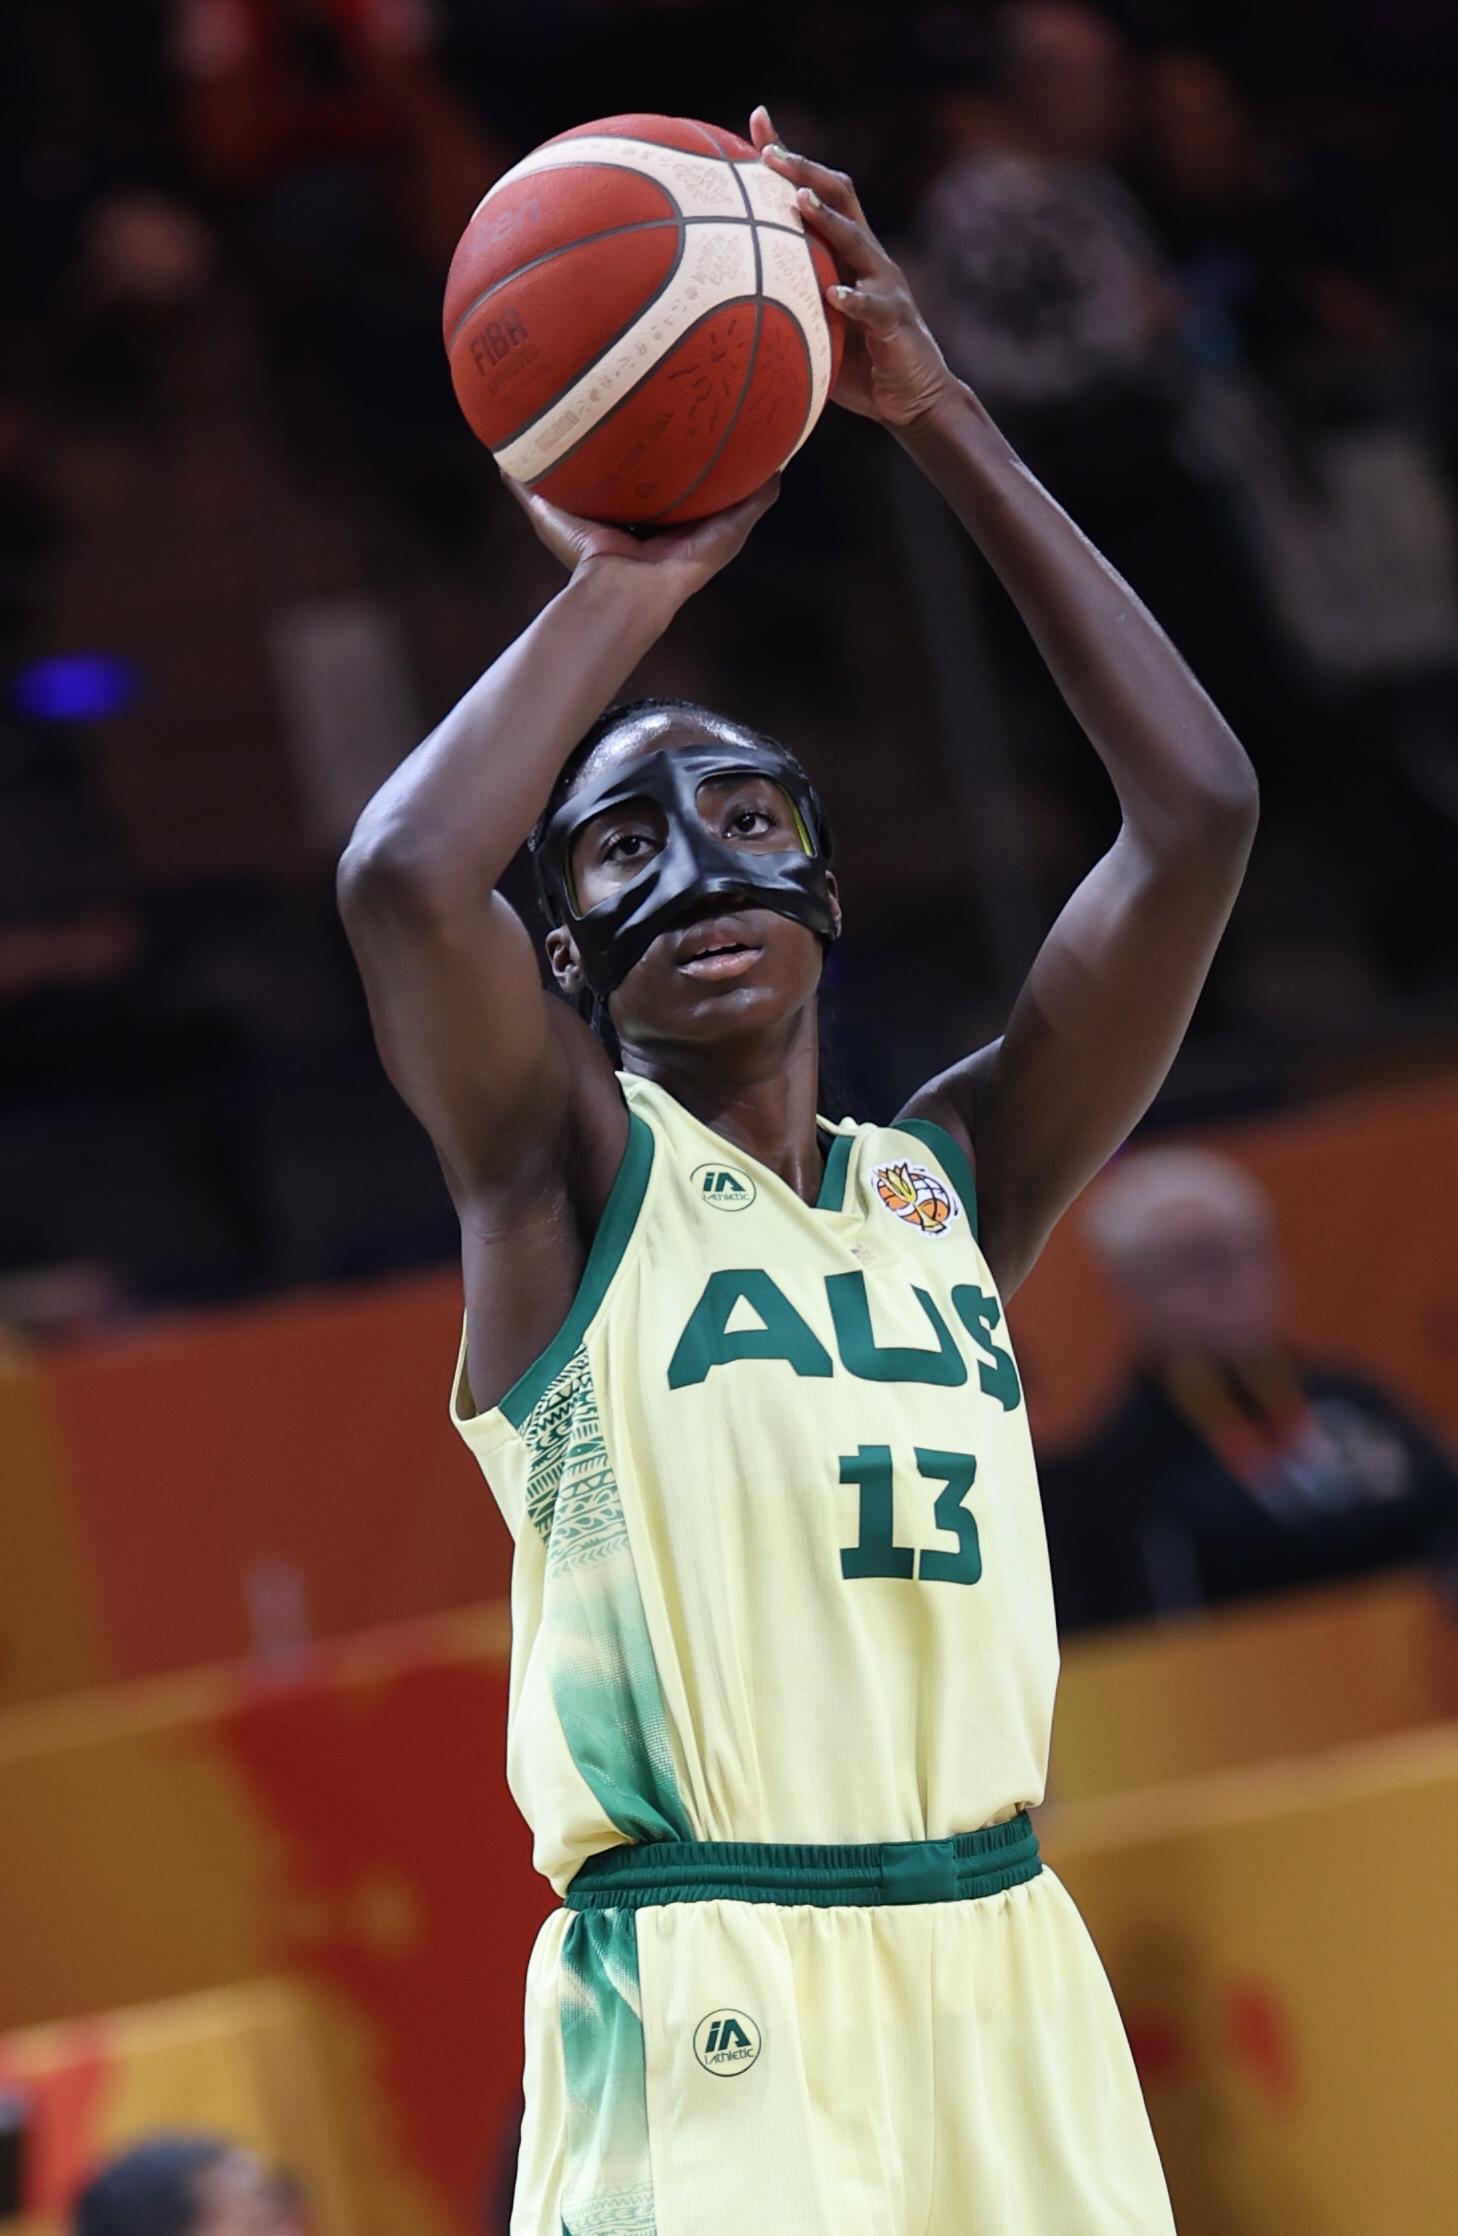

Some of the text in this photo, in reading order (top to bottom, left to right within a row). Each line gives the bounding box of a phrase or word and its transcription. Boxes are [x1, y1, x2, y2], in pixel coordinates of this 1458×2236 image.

[468, 304, 529, 377] FIBA
[667, 1268, 1021, 1412] AUS
[838, 1444, 983, 1586] 13
